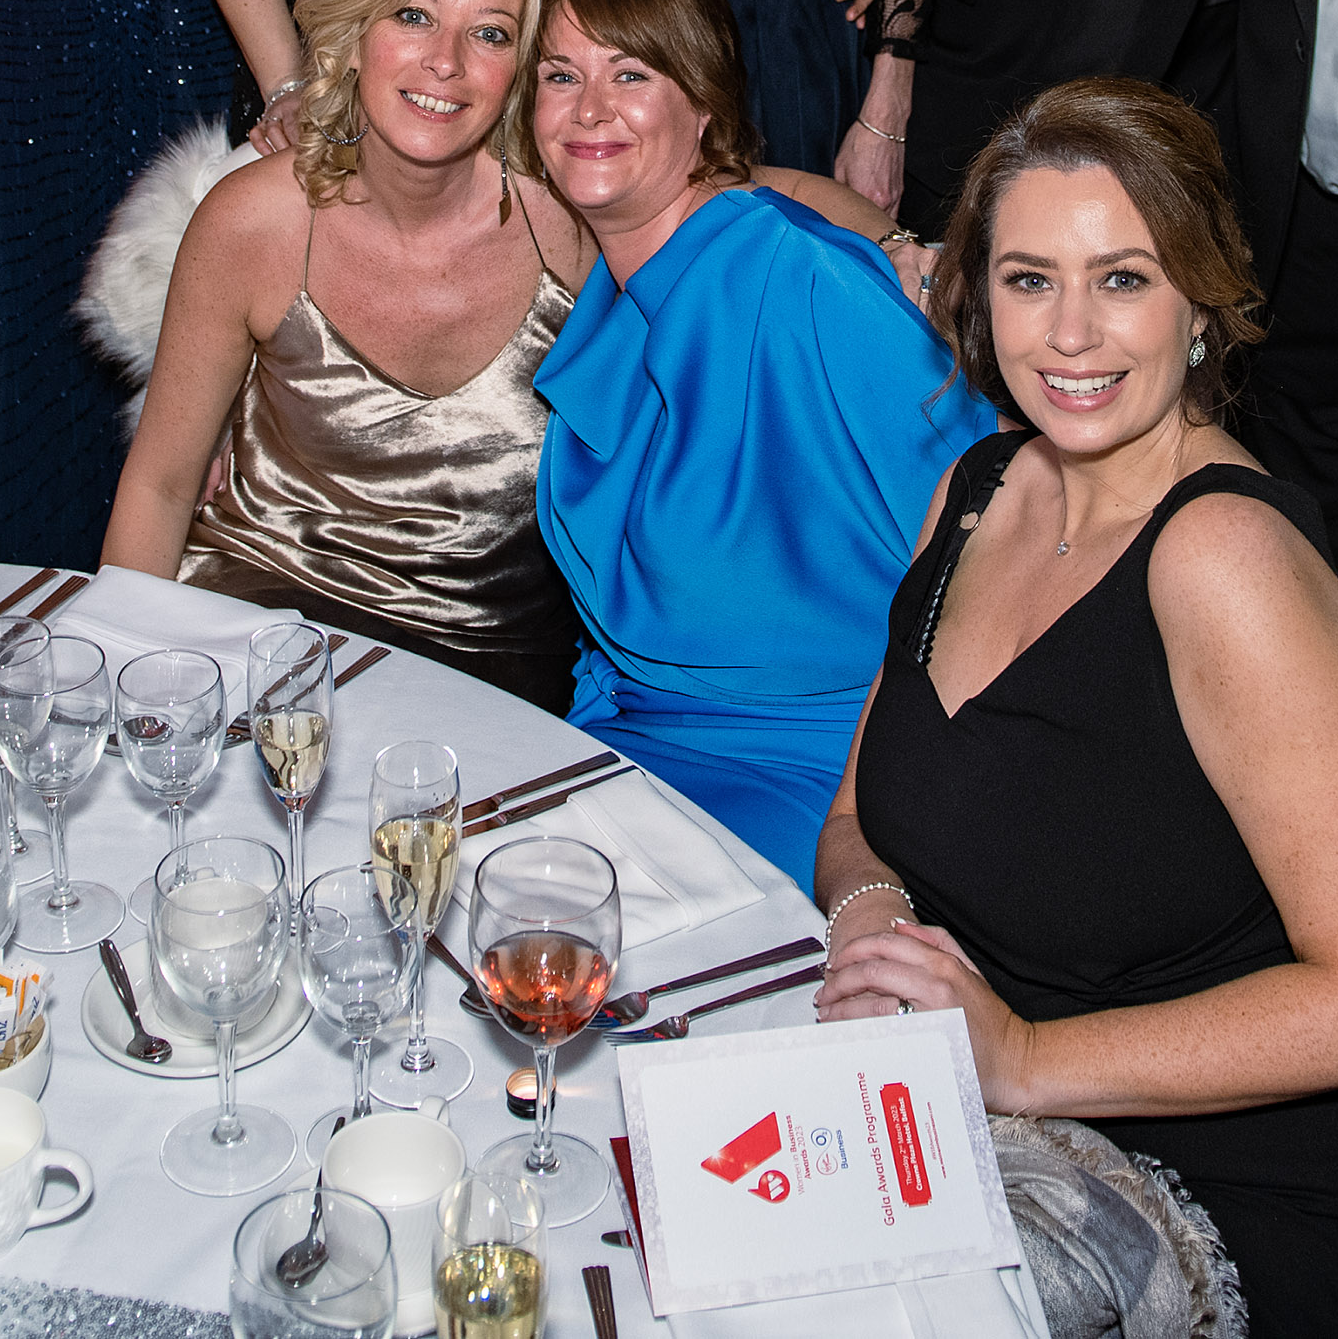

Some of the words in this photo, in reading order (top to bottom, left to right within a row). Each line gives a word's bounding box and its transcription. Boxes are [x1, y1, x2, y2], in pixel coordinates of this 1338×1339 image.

[856, 1072, 879, 1144] Programme
[890, 1105, 900, 1122] 2023
[898, 1097, 909, 1122] Belfast
[785, 1114, 797, 1153] Business
[795, 1125, 806, 1147] 2023
[894, 1123, 905, 1144] March
[835, 1129, 849, 1169] Business
[908, 1144, 918, 1163] Plaza
[794, 1164, 806, 1195] Women
[800, 1149, 812, 1180] Awards
[870, 1147, 889, 1193] Awards
[901, 1155, 914, 1185] Thursday
[912, 1164, 923, 1191] Crowne
[880, 1196, 895, 1226] Gala
